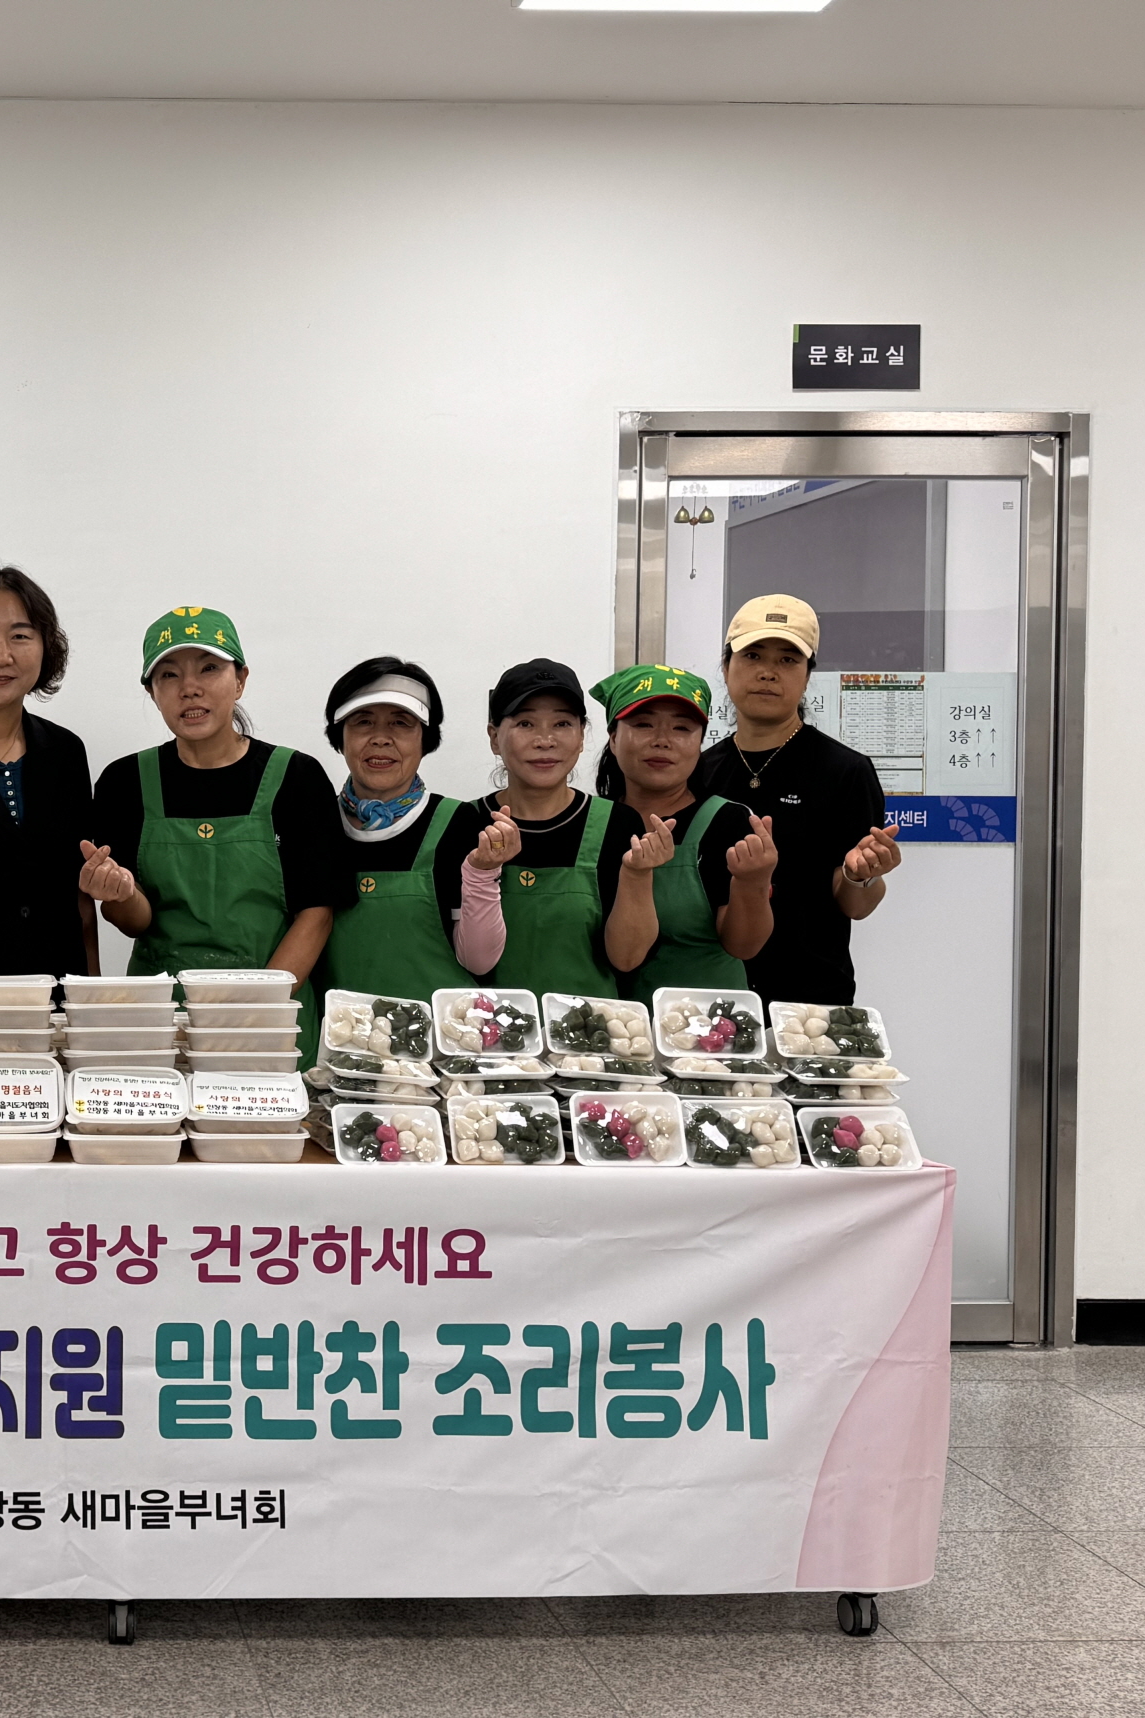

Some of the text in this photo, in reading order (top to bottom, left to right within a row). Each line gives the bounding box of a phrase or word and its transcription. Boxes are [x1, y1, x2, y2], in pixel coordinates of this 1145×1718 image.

[808, 345, 904, 366] 문화교실
[949, 705, 991, 720] 강의실
[949, 730, 971, 745] 3층
[949, 754, 971, 768] 4층
[47, 1222, 168, 1285] 항상
[190, 1224, 493, 1286] 건강하세요
[154, 1319, 410, 1440] 밑반찬
[432, 1317, 776, 1440] 조리봉사
[61, 1488, 287, 1531] 새마을부녀회
